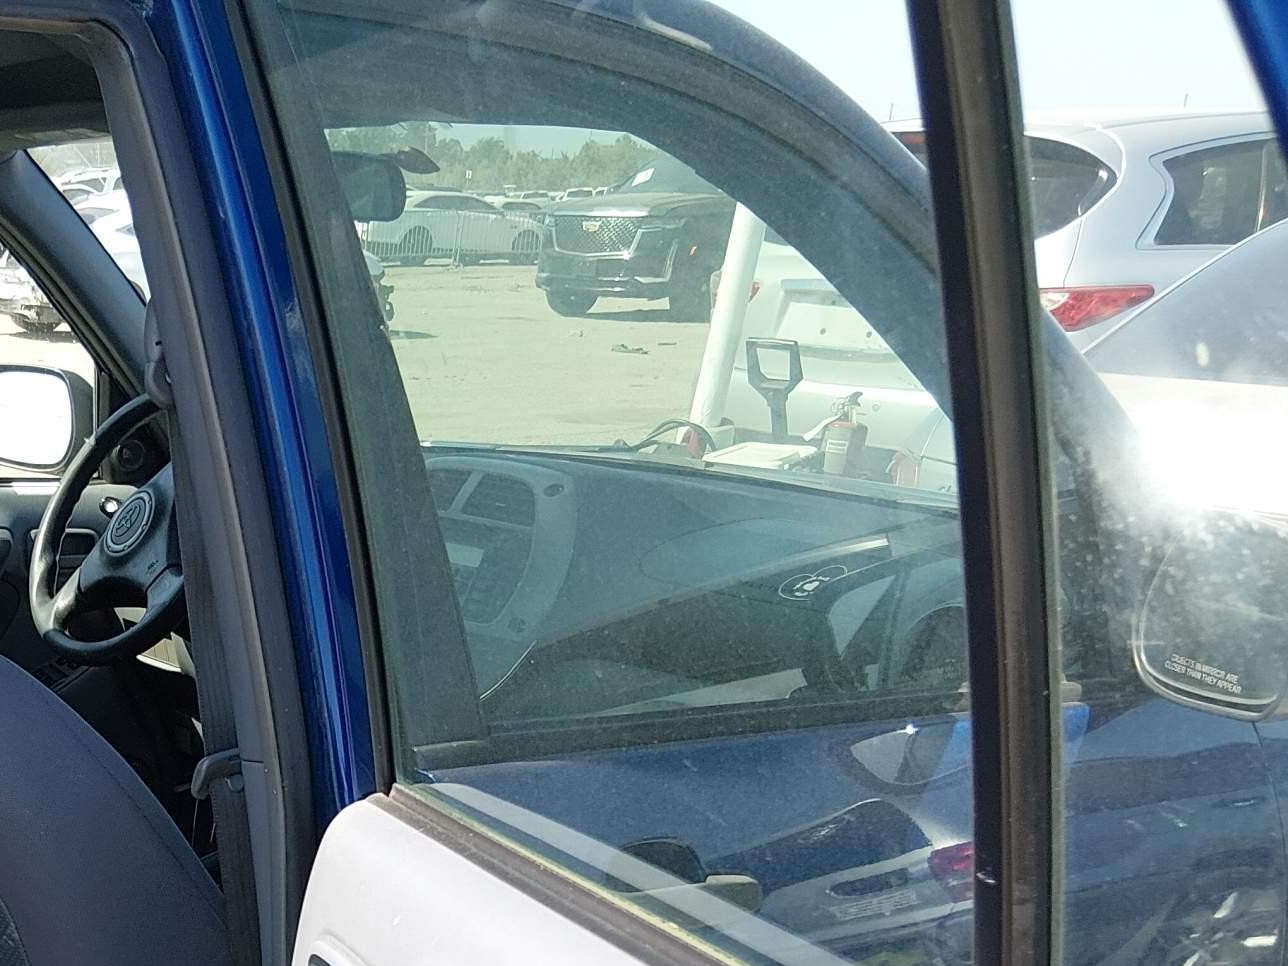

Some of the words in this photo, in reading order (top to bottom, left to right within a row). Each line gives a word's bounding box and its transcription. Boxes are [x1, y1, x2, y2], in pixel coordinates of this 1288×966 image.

[1164, 660, 1187, 673] CLOSER
[1186, 668, 1202, 680] THAN
[1201, 673, 1218, 685] THEY
[1216, 679, 1242, 694] APPEAR
[1225, 673, 1239, 684] ARE
